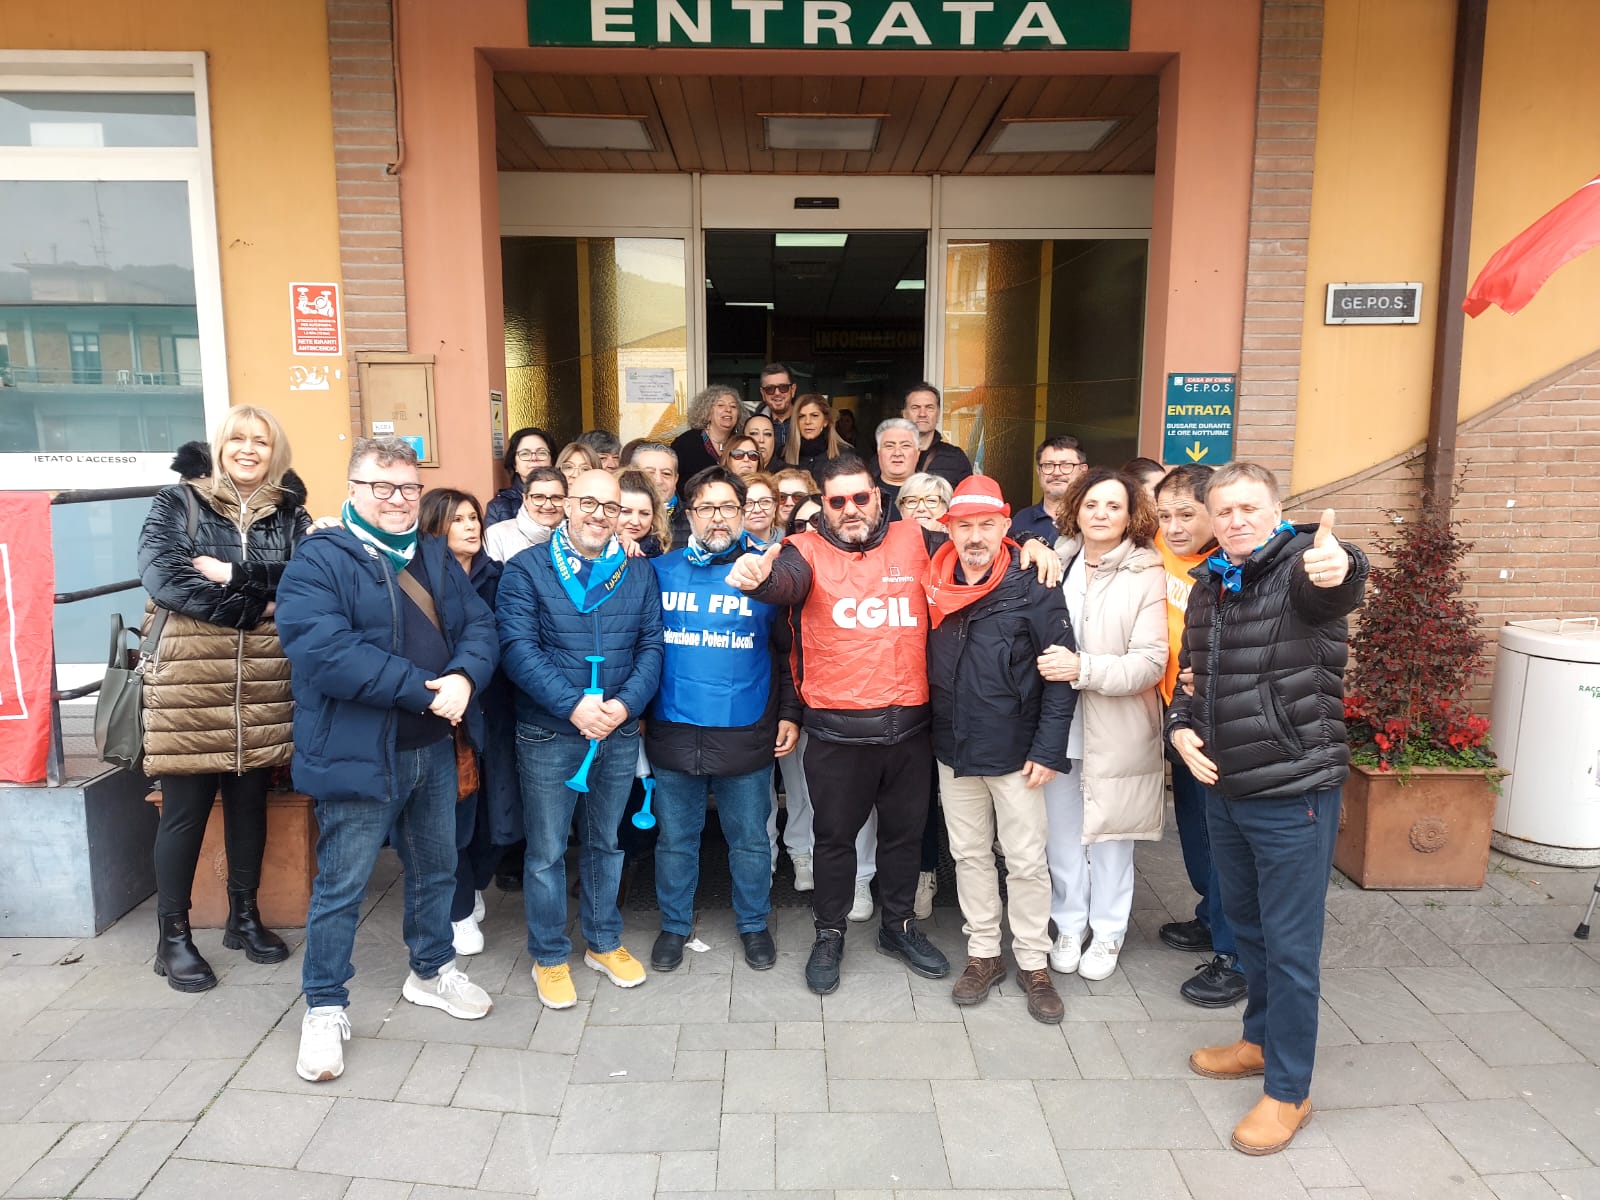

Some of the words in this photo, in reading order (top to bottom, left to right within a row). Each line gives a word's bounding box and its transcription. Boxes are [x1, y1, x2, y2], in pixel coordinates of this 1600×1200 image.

[590, 0, 1068, 46] ENTRATA
[1341, 296, 1408, 310] GE.P.O.S.
[1184, 384, 1233, 392] GE.P.O.S.
[1167, 405, 1232, 416] ENTRATA
[76, 455, 137, 463] L'ACCESSO
[661, 591, 699, 612] UIL
[708, 593, 753, 617] FPL
[832, 597, 918, 629] CGIL
[702, 629, 730, 649] Poteri
